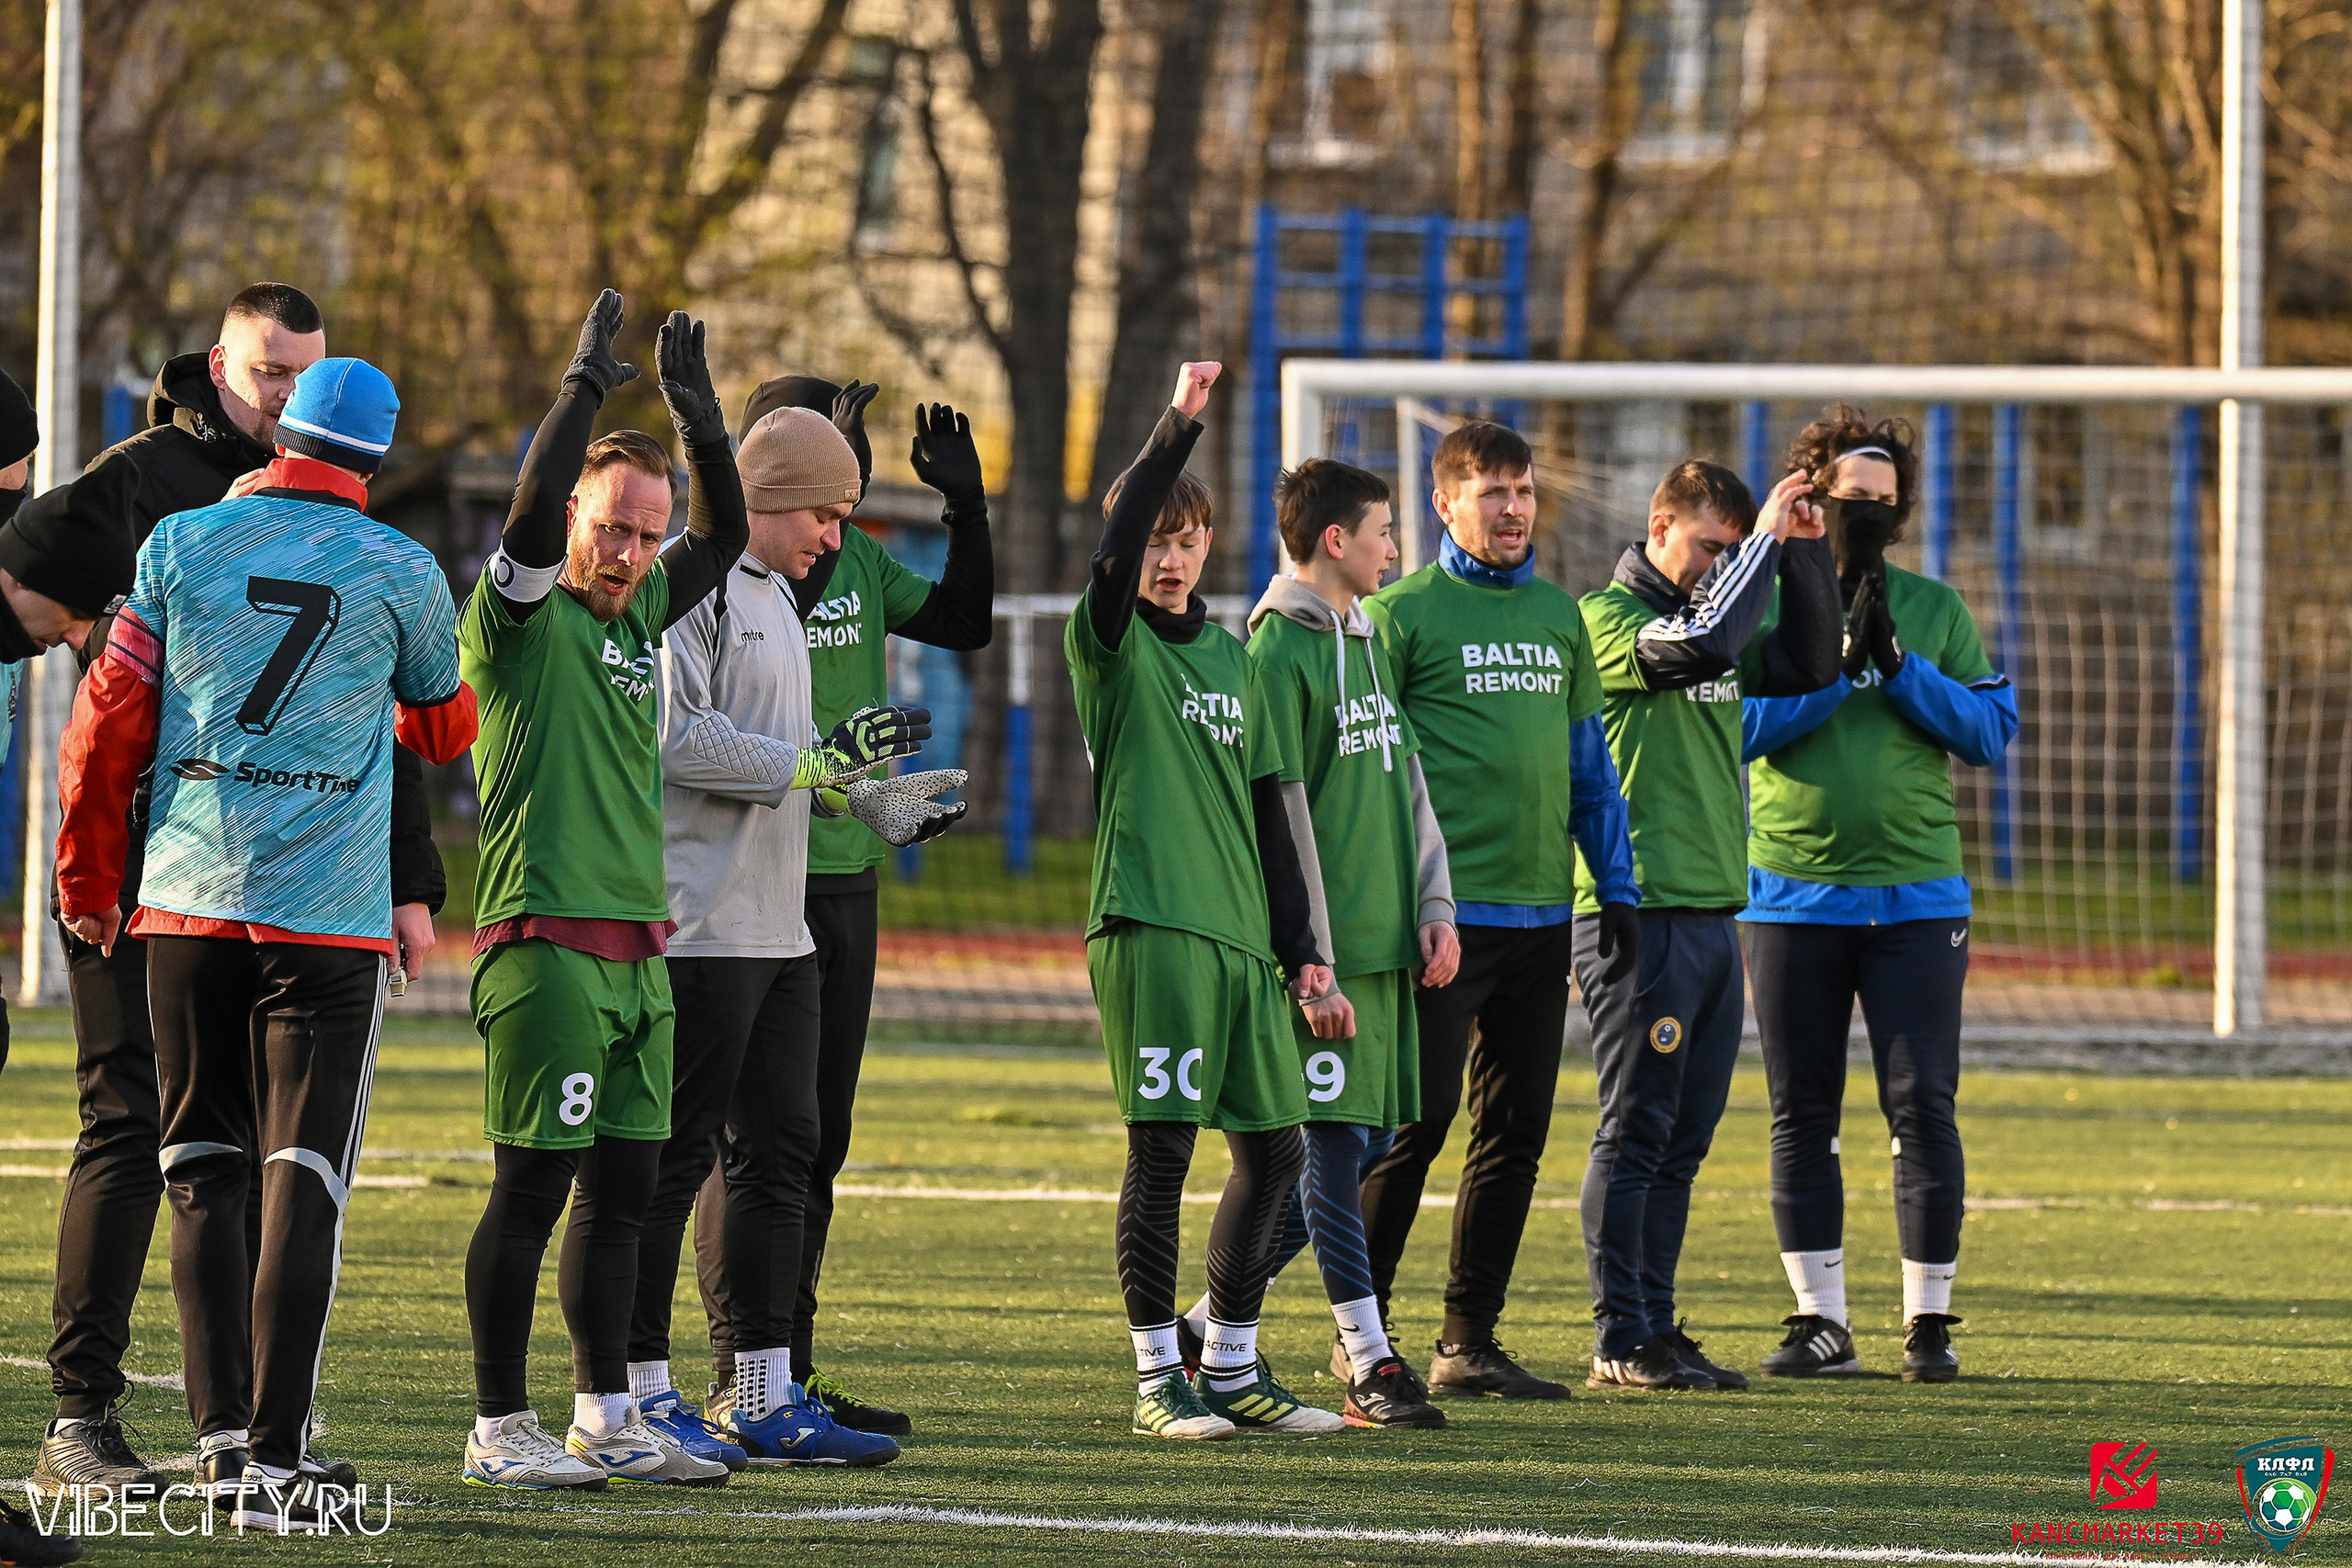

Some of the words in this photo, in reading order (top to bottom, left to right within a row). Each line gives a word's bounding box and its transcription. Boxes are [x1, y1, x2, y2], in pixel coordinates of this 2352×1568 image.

[234, 575, 342, 737] 7
[741, 629, 764, 643] mitre
[1461, 642, 1562, 670] BALTIA
[1465, 671, 1563, 694] REMONT
[1137, 1047, 1204, 1101] 30
[559, 1072, 594, 1126] 8
